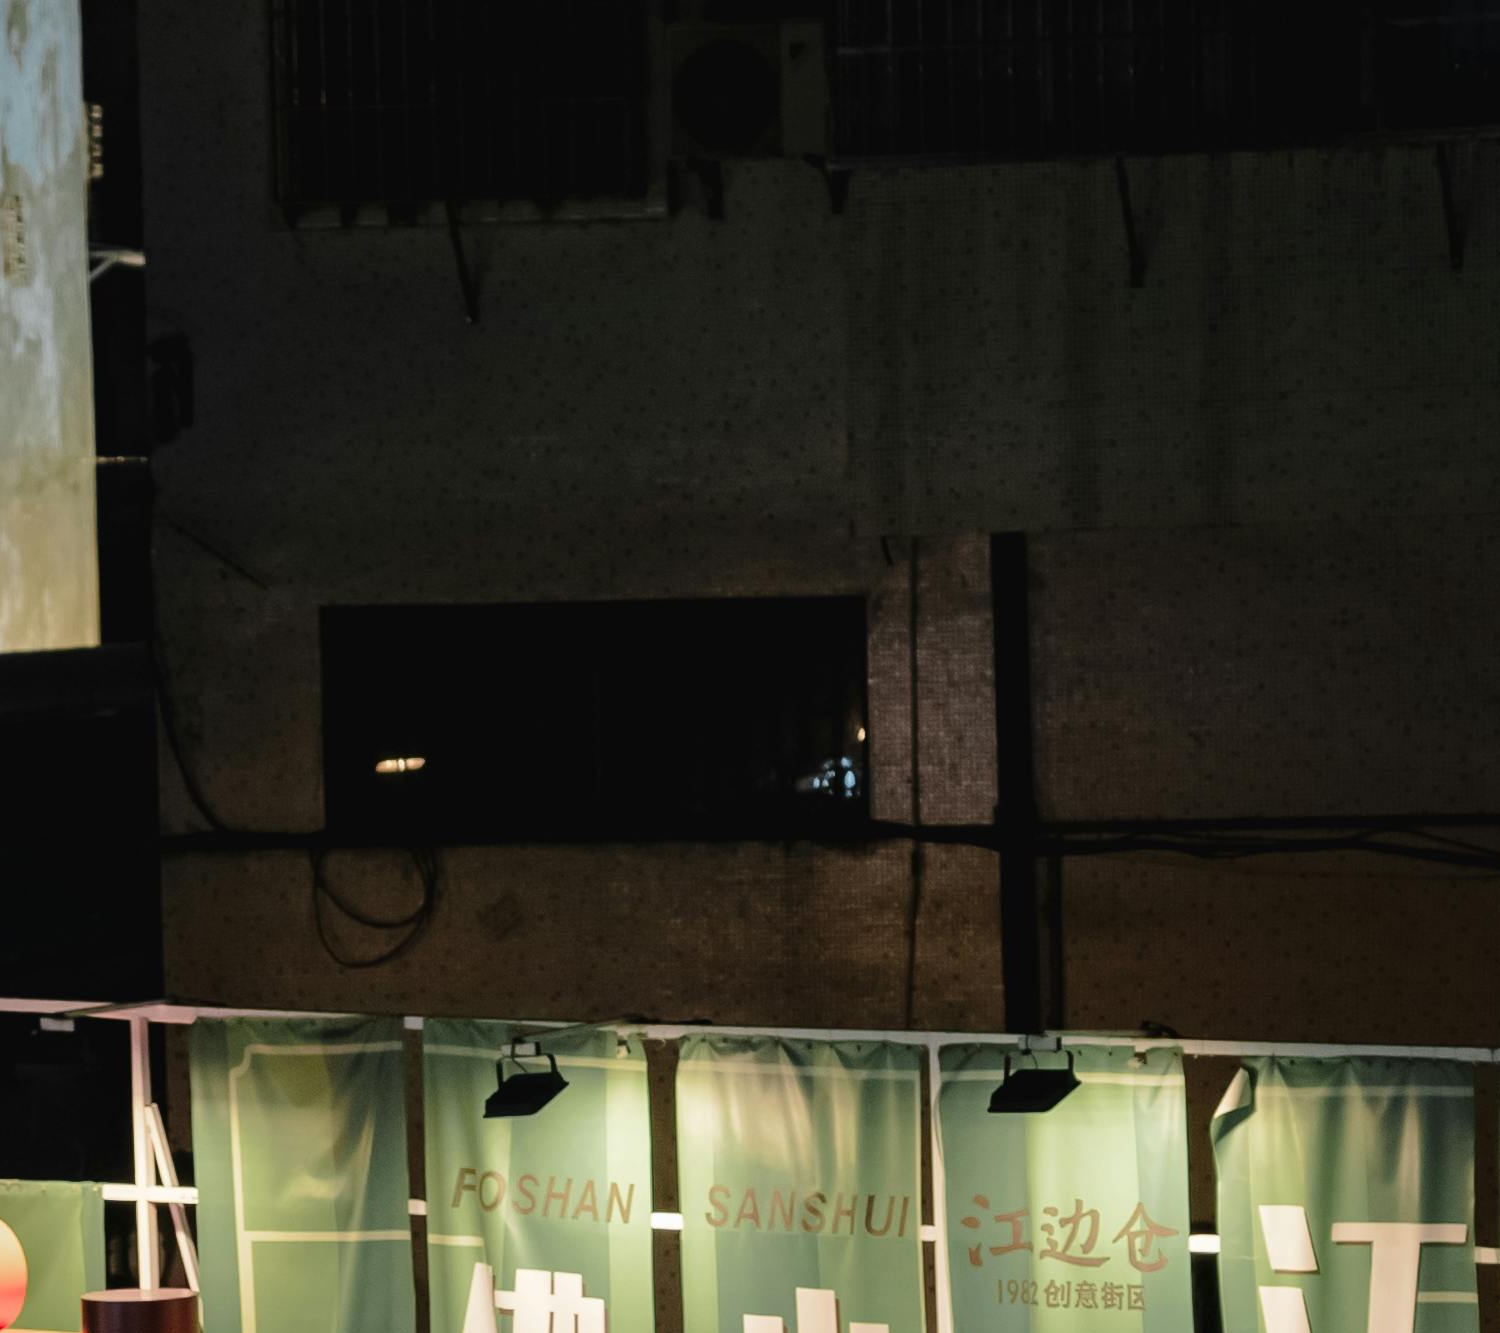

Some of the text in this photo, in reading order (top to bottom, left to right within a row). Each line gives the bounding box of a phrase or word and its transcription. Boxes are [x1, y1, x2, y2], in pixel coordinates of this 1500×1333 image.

[452, 1166, 912, 1239] FOSHAN SANSHUI
[961, 1195, 1180, 1274] 江边仓
[1042, 1279, 1148, 1312] 创意街区
